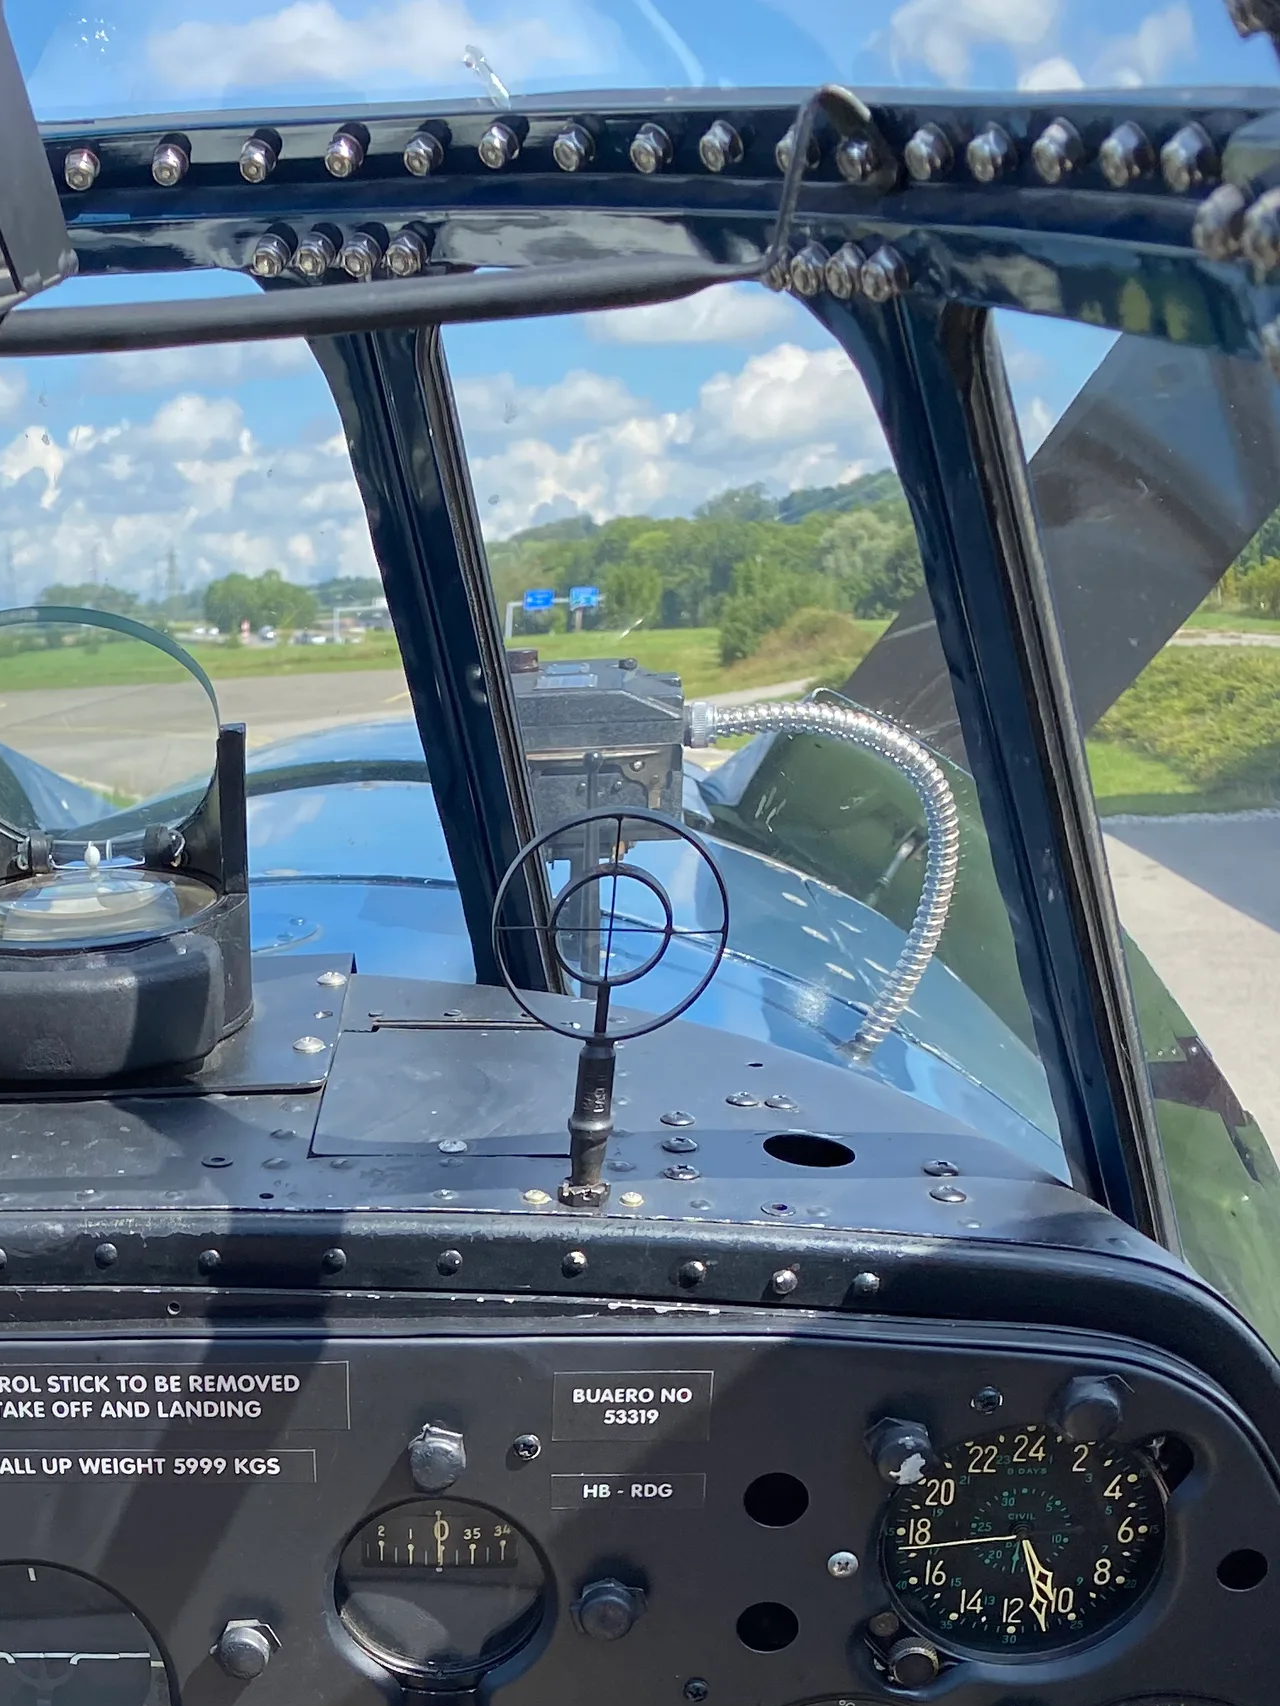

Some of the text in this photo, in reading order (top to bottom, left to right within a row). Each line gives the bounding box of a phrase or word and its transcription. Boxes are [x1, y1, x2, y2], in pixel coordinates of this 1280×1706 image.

[47, 1376, 109, 1394] STICK
[115, 1376, 148, 1393] TO
[154, 1376, 182, 1393] BE
[189, 1375, 300, 1393] REMOVED
[573, 1388, 692, 1403] BUAERO NO
[52, 1401, 94, 1419] OFF
[99, 1401, 151, 1418] AND
[158, 1401, 262, 1418] LANDING
[603, 1409, 659, 1424] 53319
[1012, 1435, 1046, 1462] 24
[0, 1458, 37, 1474] ALL
[42, 1458, 73, 1475] UP
[79, 1458, 167, 1475] WEIGHT
[173, 1458, 227, 1475] 5999
[235, 1458, 281, 1474] KGS
[968, 1446, 998, 1473] 22
[583, 1484, 611, 1498] HB
[631, 1484, 673, 1498] RDG
